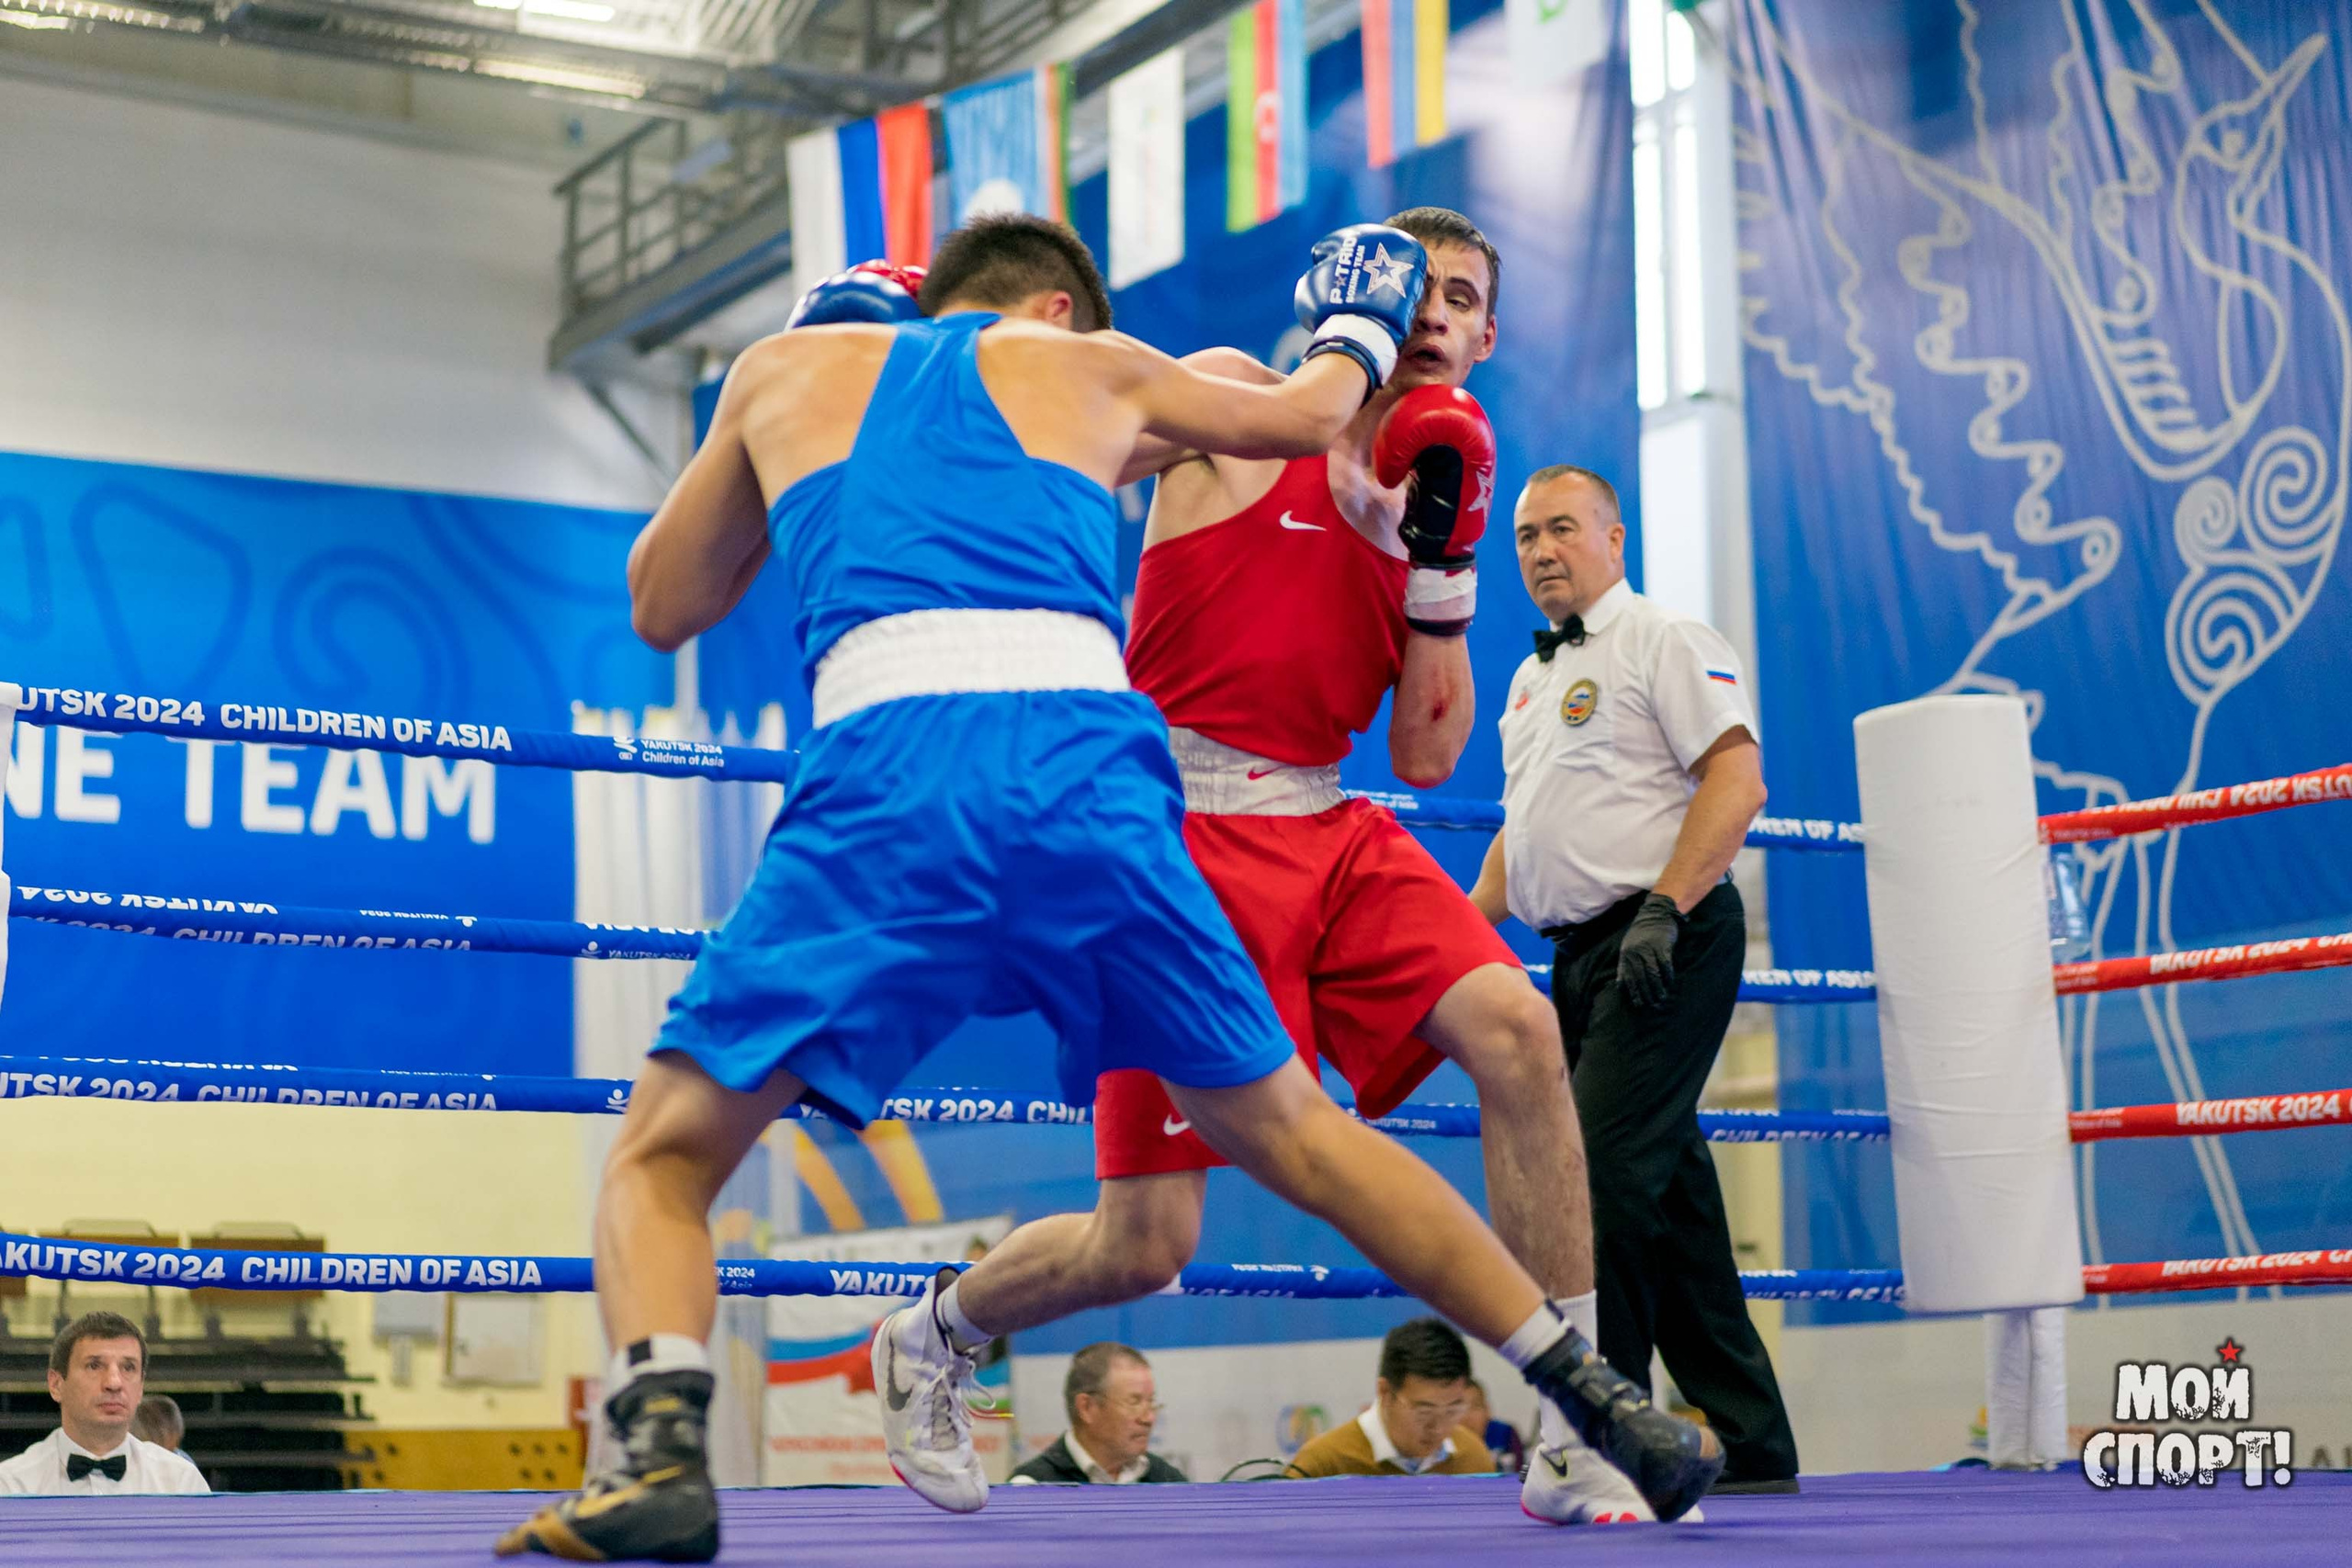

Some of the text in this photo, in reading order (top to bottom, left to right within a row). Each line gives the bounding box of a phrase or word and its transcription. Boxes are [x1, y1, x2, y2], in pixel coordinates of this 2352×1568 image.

[1353, 245, 1365, 267] TEAM
[114, 694, 205, 726] 2024
[220, 704, 387, 739] CHILDREN
[392, 716, 433, 743] OF
[436, 722, 512, 751] ASIA
[640, 739, 722, 754] YAKUTSK 2024
[642, 750, 724, 768] Children of Asia
[165, 735, 495, 844] TEAM
[937, 1099, 1014, 1122] 2024
[2177, 1092, 2341, 1126] YAKUTSK 2024
[0, 1241, 542, 1286] KUTSK 2024 CHILDREN OF ASIA
[726, 1267, 755, 1278] 2024
